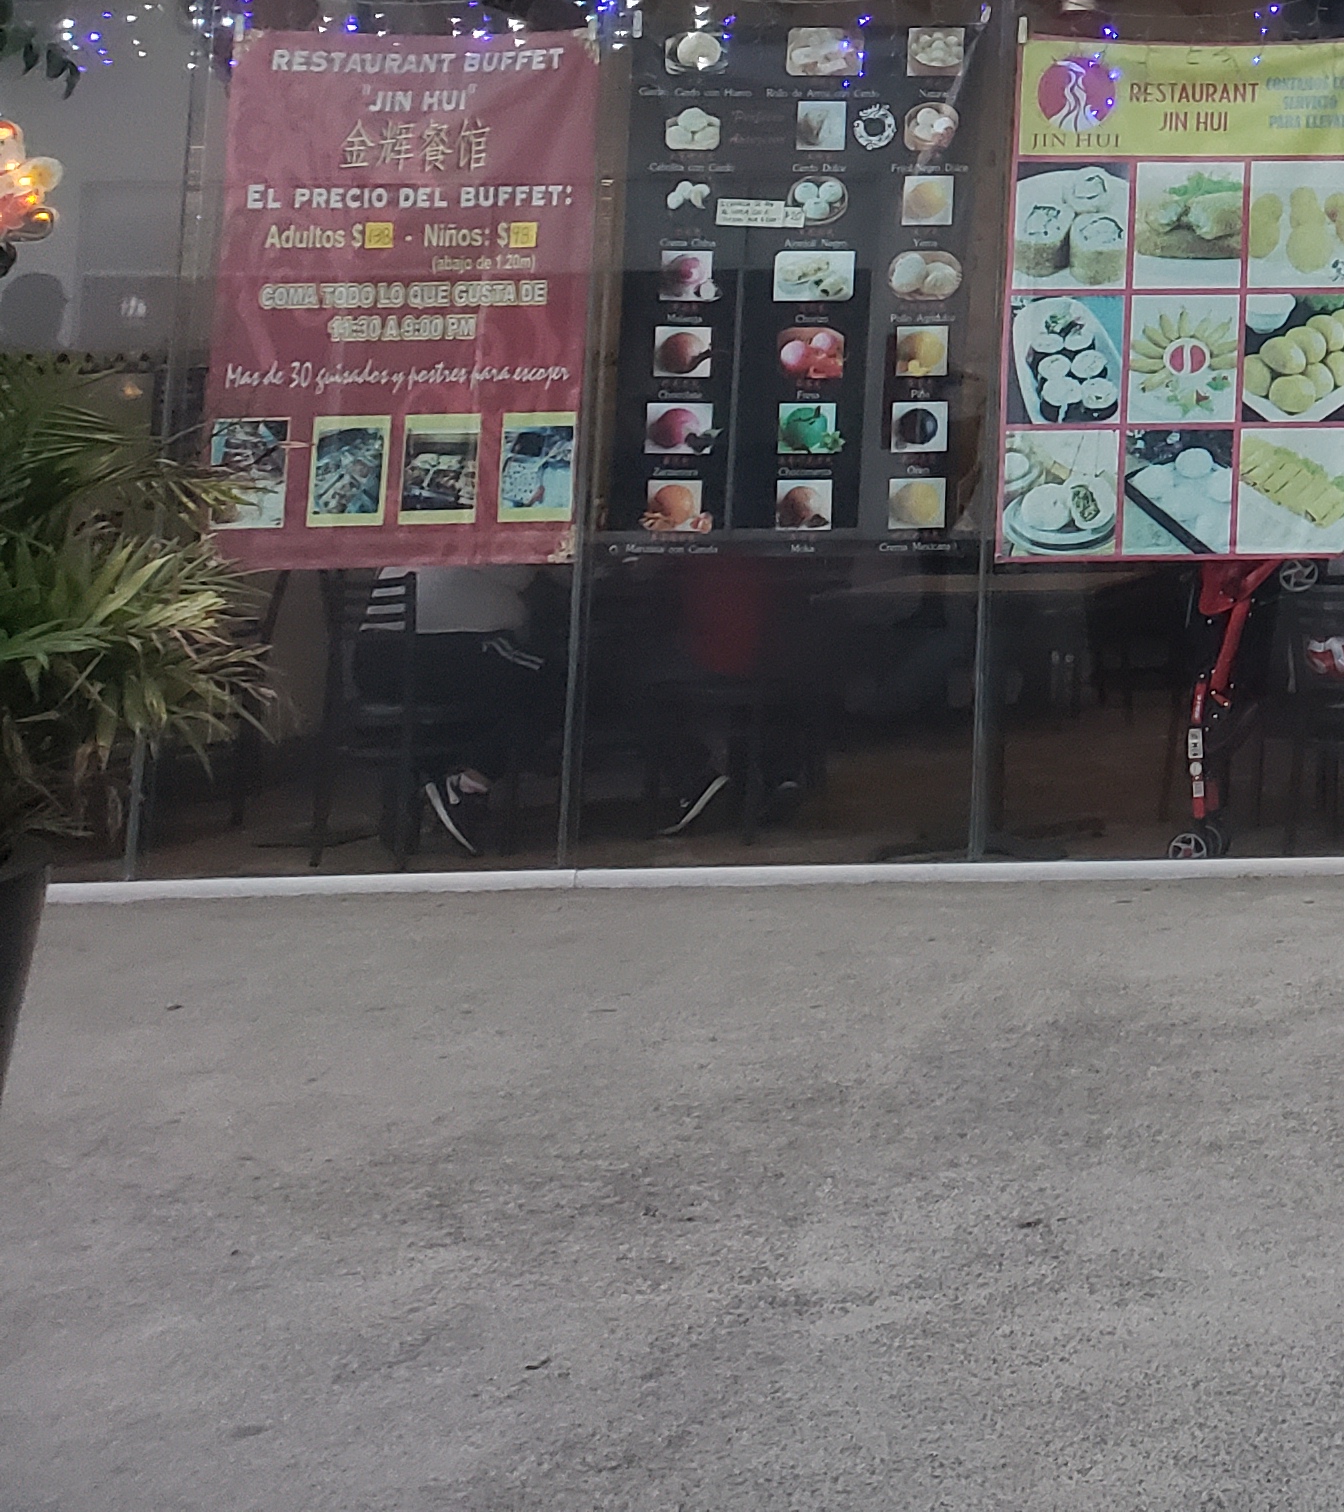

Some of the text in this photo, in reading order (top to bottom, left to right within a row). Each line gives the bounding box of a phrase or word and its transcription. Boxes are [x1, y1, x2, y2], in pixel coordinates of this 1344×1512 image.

[272, 47, 564, 74] RESTAURANT BUFFET
[1129, 81, 1260, 104] RESTAURANT
[1159, 111, 1229, 133] JIN HUI
[1032, 132, 1120, 150] JIN HUI
[294, 187, 388, 209] PRECIO
[399, 187, 448, 208] DEL
[460, 184, 573, 208] BUFFET:
[264, 224, 346, 248] Adultos
[476, 254, 492, 270] de
[259, 280, 547, 310] COMA TODO LO QUE GUSTA DE
[381, 315, 401, 341] A
[445, 313, 477, 340] PM
[225, 363, 261, 388] Mas
[261, 360, 286, 386] de
[289, 361, 312, 388] 30
[407, 362, 467, 390] postres
[470, 365, 511, 390] para
